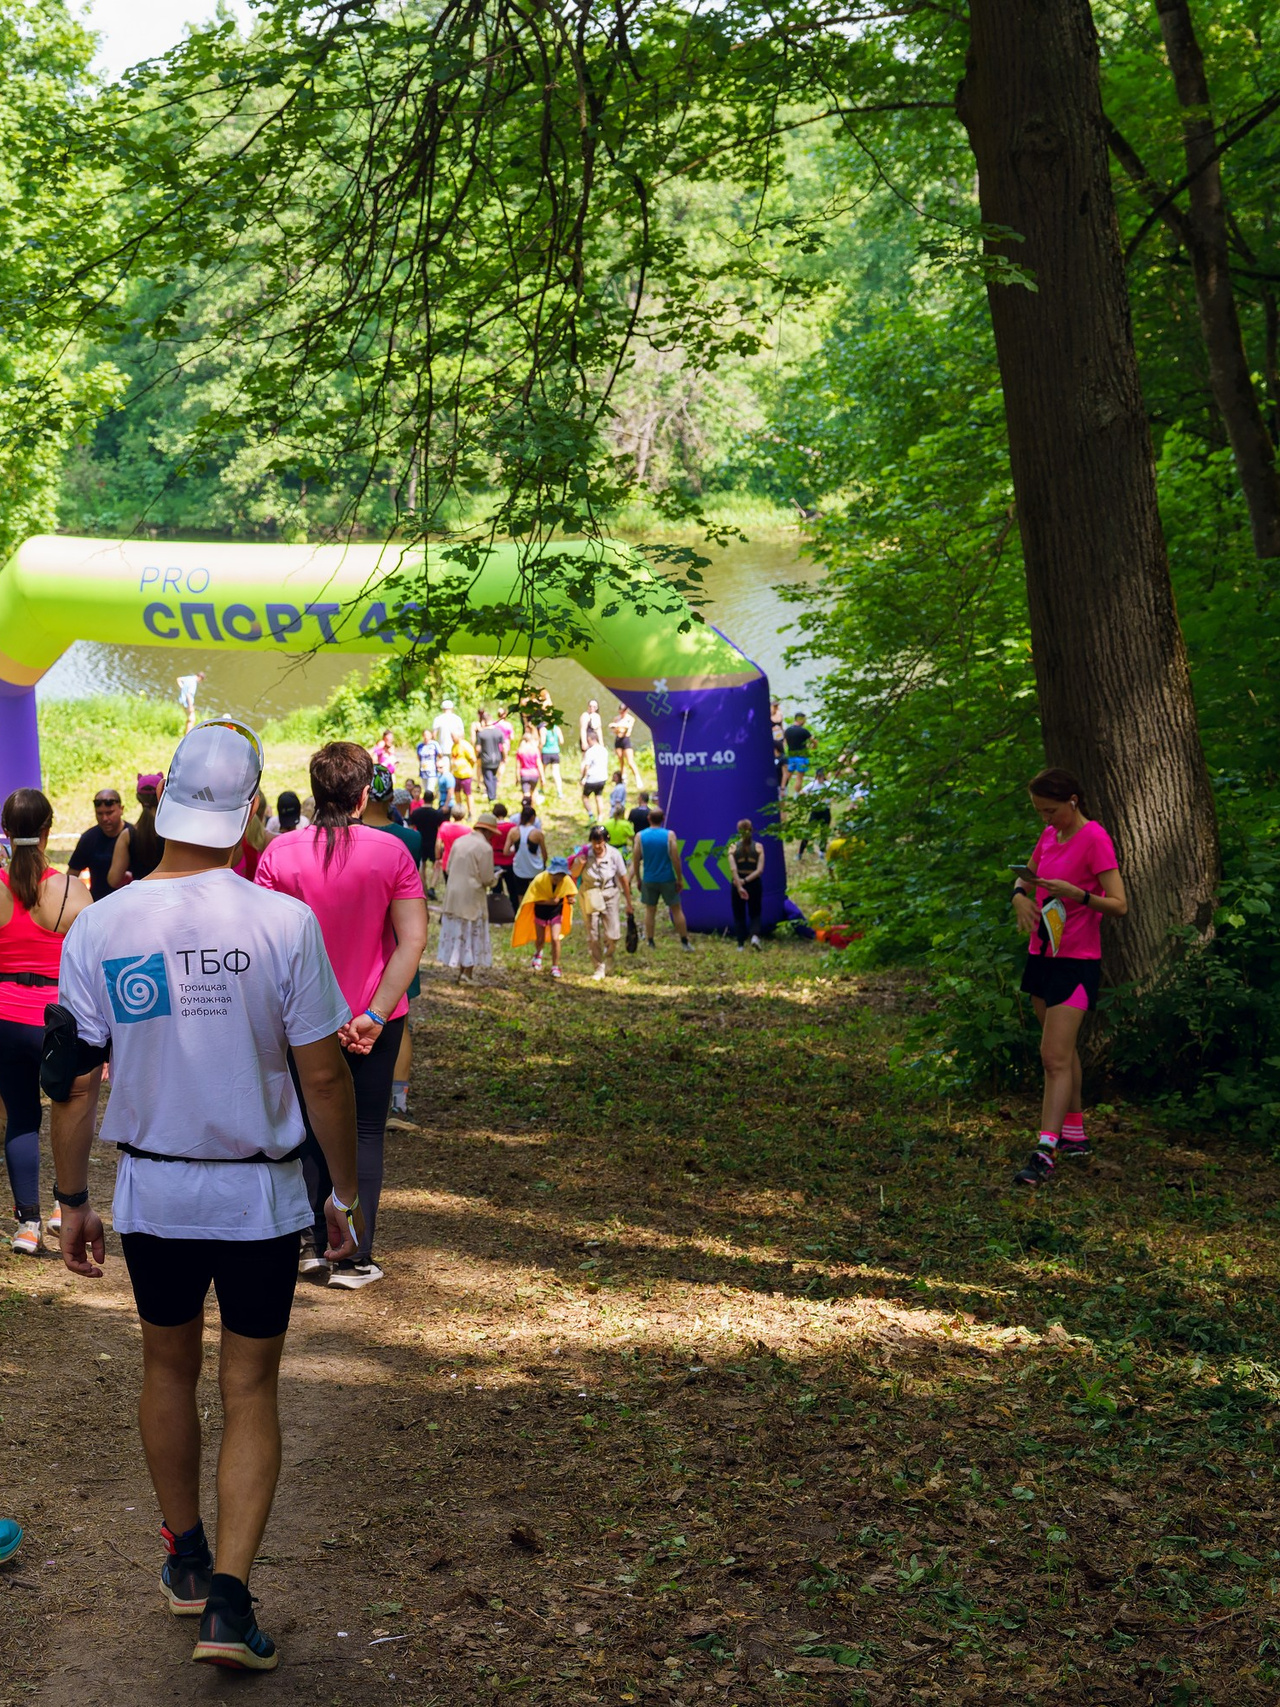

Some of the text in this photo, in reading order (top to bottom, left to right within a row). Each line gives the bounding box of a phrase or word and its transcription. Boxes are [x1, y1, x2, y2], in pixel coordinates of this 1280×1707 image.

[140, 566, 211, 594] PRO
[142, 601, 342, 644] СПОРТ
[658, 749, 736, 766] СПОРТ 40
[176, 948, 251, 976] ТБФ
[179, 983, 227, 992] Троицкая
[180, 995, 232, 1005] бумажная
[181, 1007, 228, 1018] фабрика
